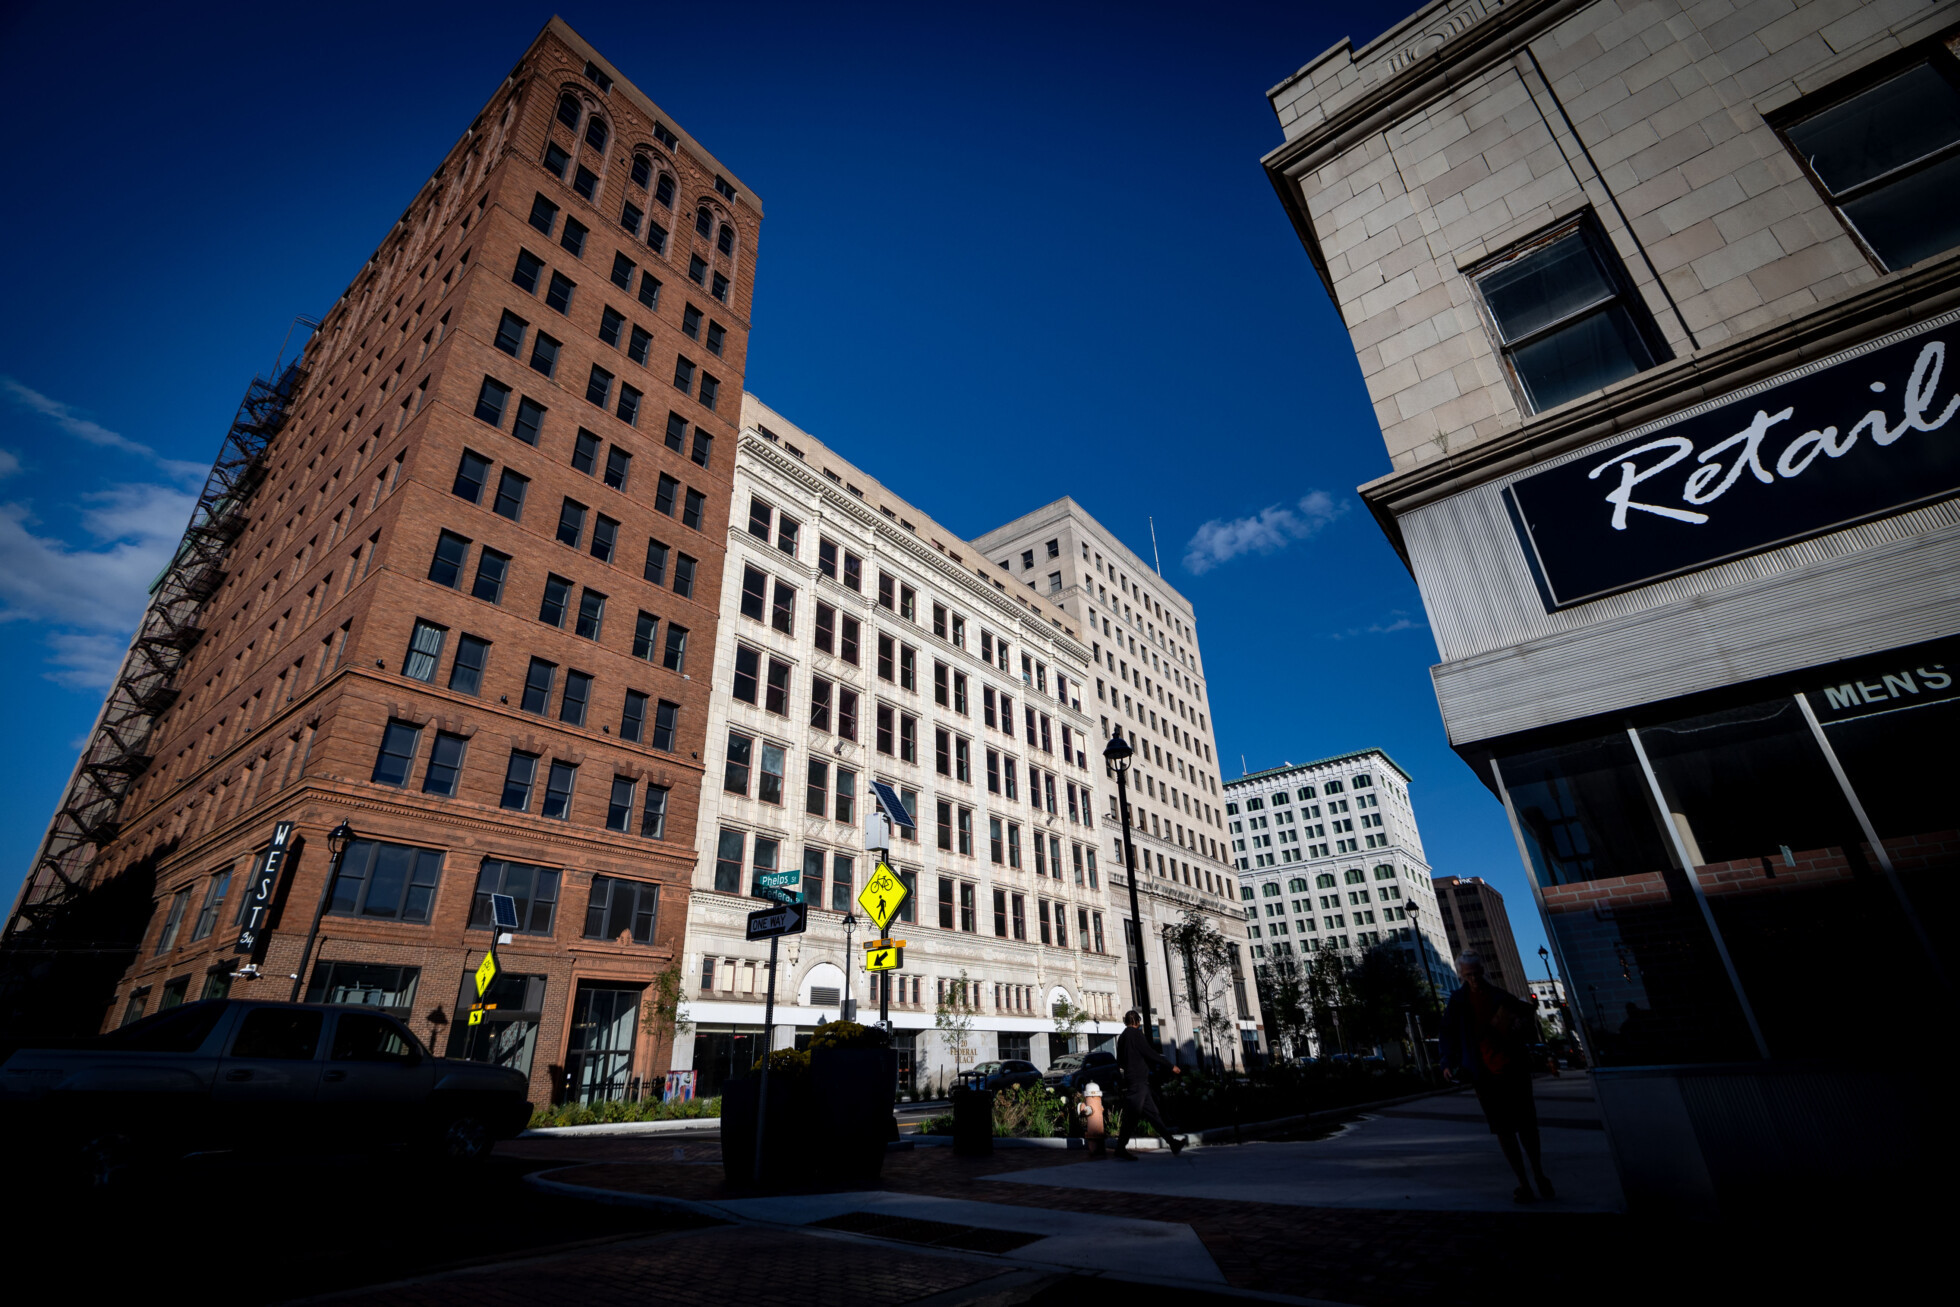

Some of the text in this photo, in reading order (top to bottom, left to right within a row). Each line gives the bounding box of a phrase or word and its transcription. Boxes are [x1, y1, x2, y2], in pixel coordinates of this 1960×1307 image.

[1588, 341, 1960, 531] Retail
[1823, 665, 1953, 710] MENS
[240, 825, 290, 948] WEST 34
[761, 886, 793, 903] Federal
[762, 874, 789, 886] Phelps
[752, 914, 786, 931] ONE WAY
